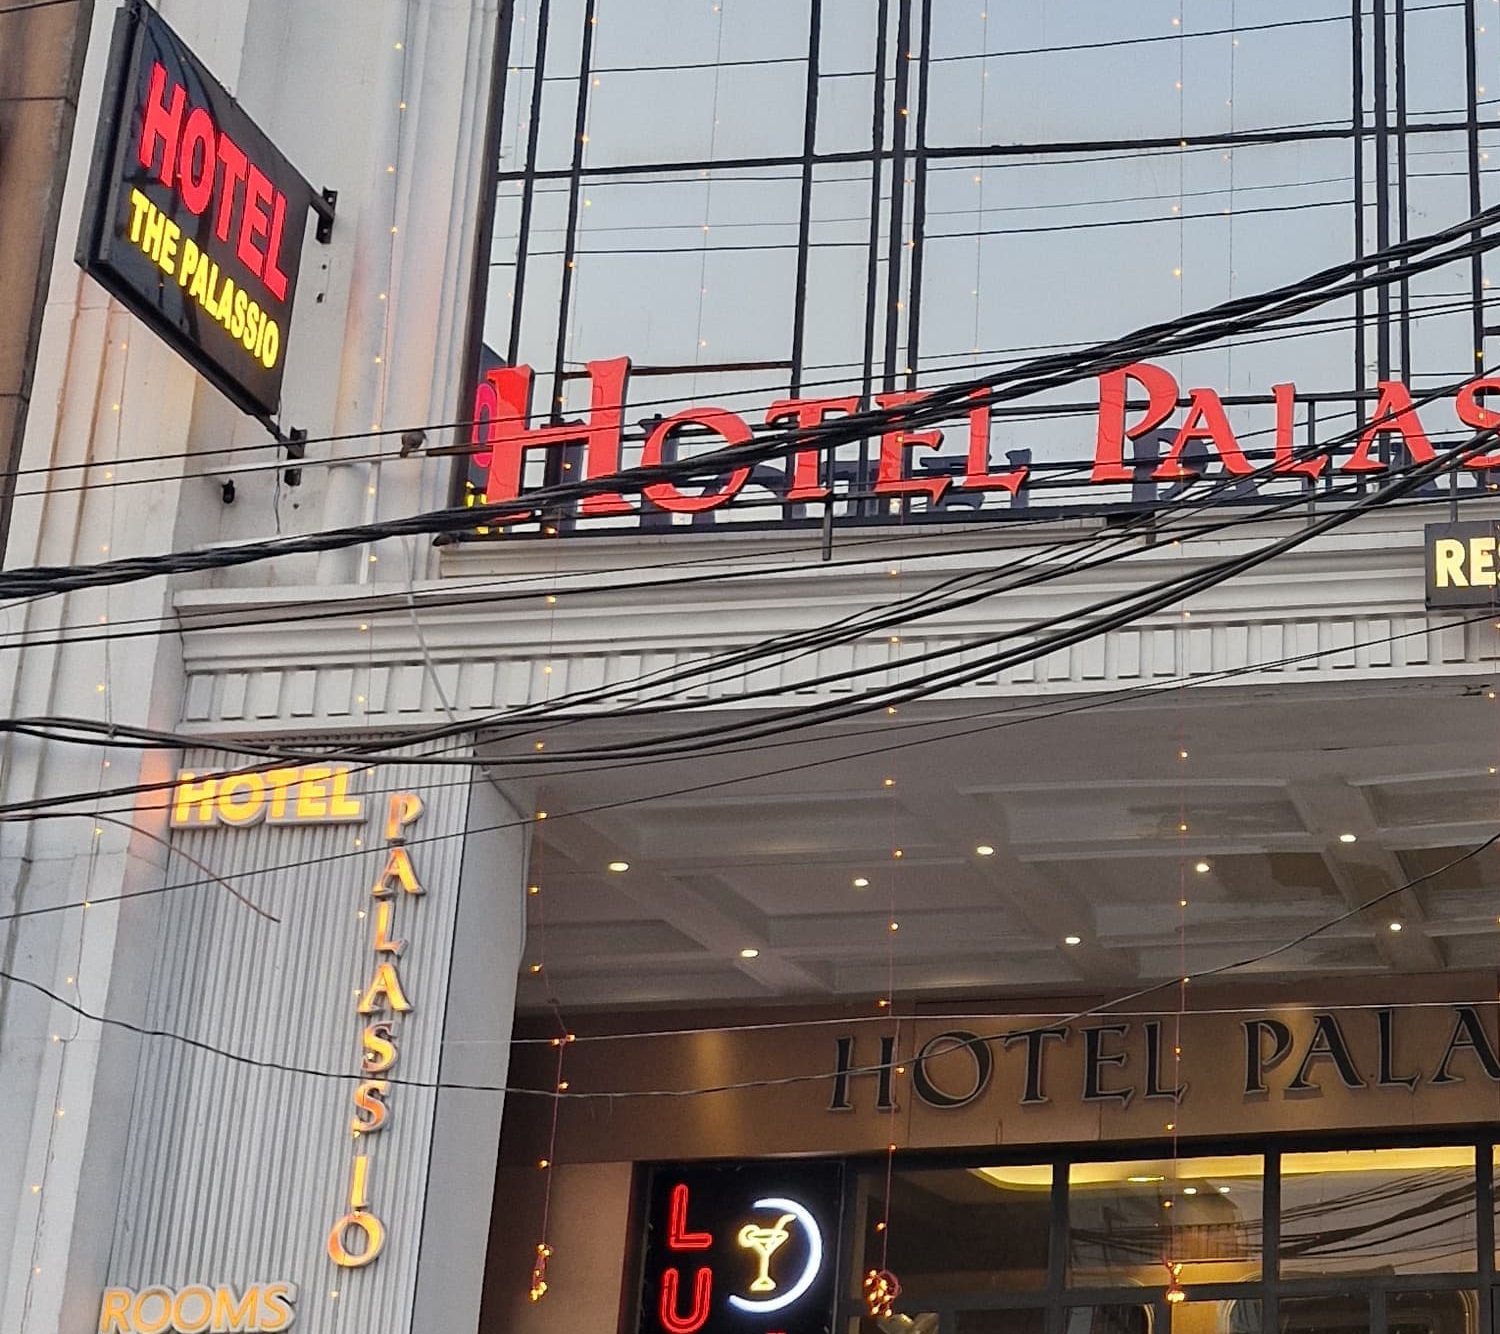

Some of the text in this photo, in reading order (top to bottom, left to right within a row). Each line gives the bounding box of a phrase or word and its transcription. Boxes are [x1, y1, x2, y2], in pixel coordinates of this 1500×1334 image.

[137, 60, 289, 303] HOTEL
[127, 189, 281, 371] THE PALASSIO
[487, 355, 1030, 520] HOTEL
[174, 767, 366, 829] HOTEL
[328, 791, 427, 1269] PALASSIO
[827, 1014, 1189, 1112] HOTEL
